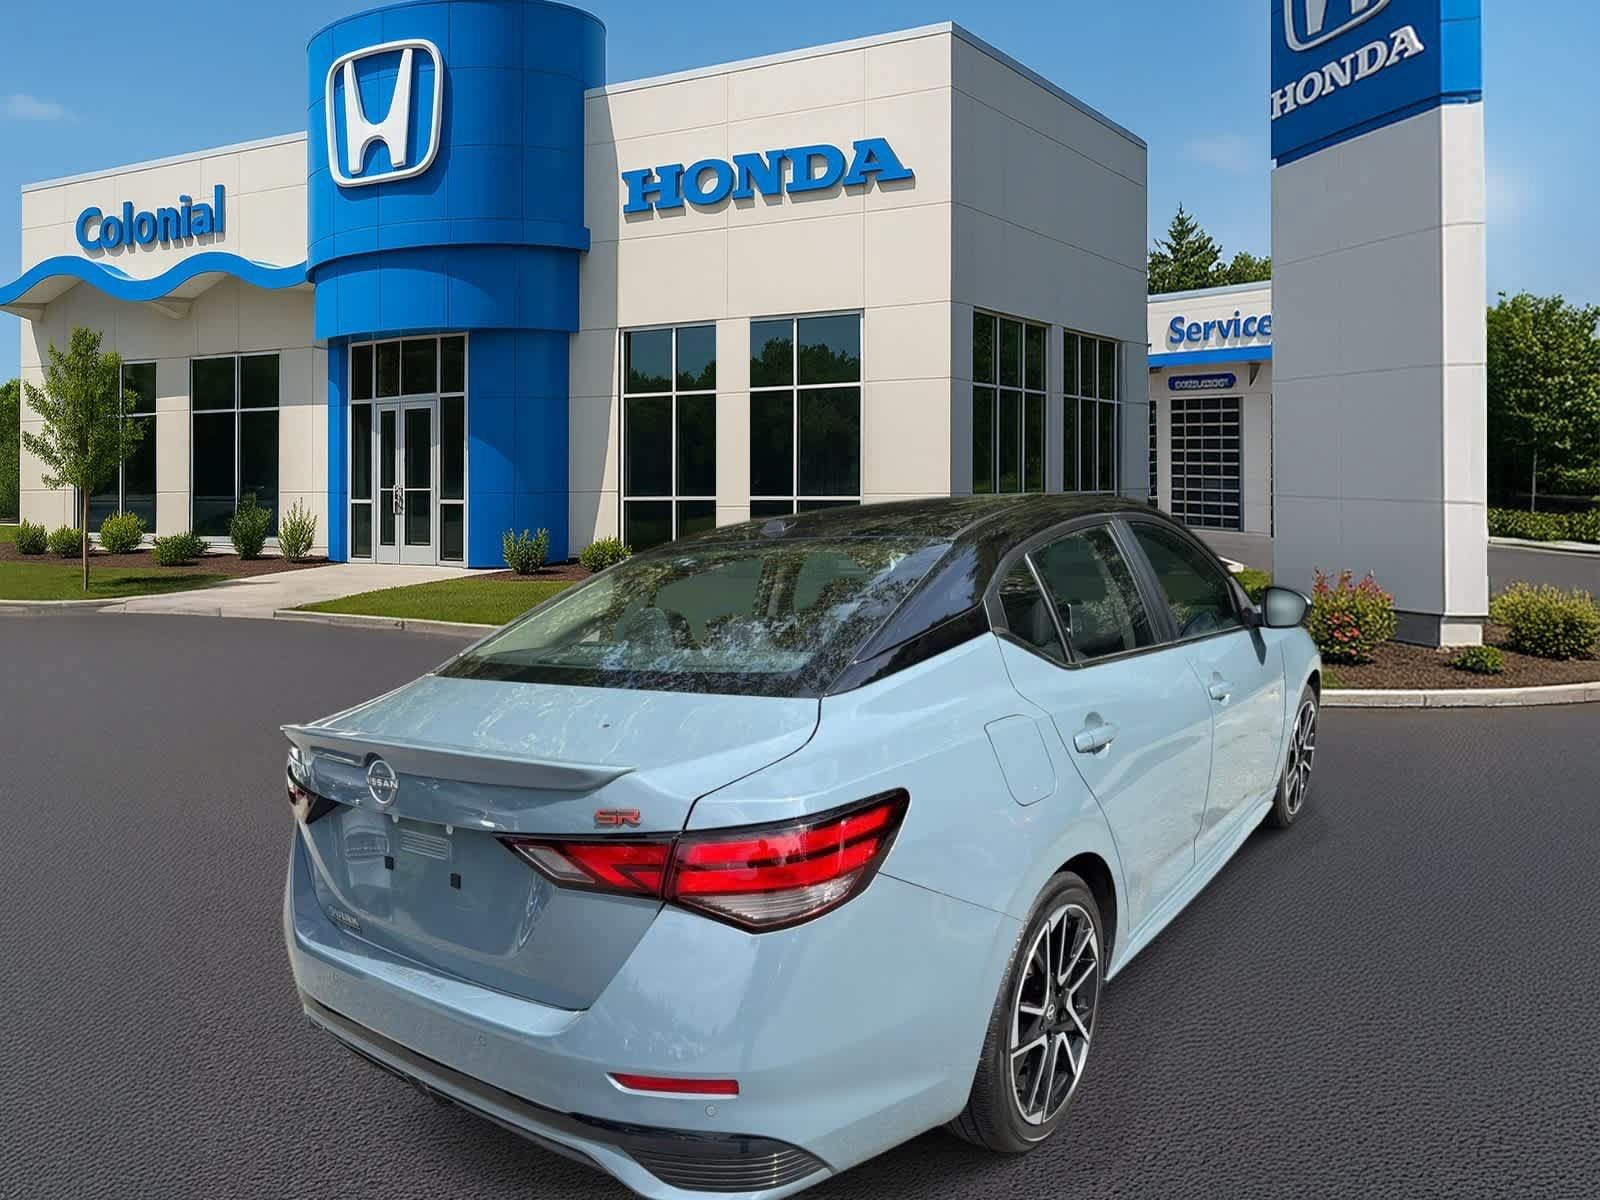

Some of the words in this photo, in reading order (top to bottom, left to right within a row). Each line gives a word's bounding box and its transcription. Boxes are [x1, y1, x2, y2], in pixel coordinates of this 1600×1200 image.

[1271, 25, 1424, 120] HONDA
[621, 137, 912, 213] HONDA
[76, 184, 225, 250] Colonial
[1169, 310, 1272, 344] Service
[594, 808, 641, 828] SR
